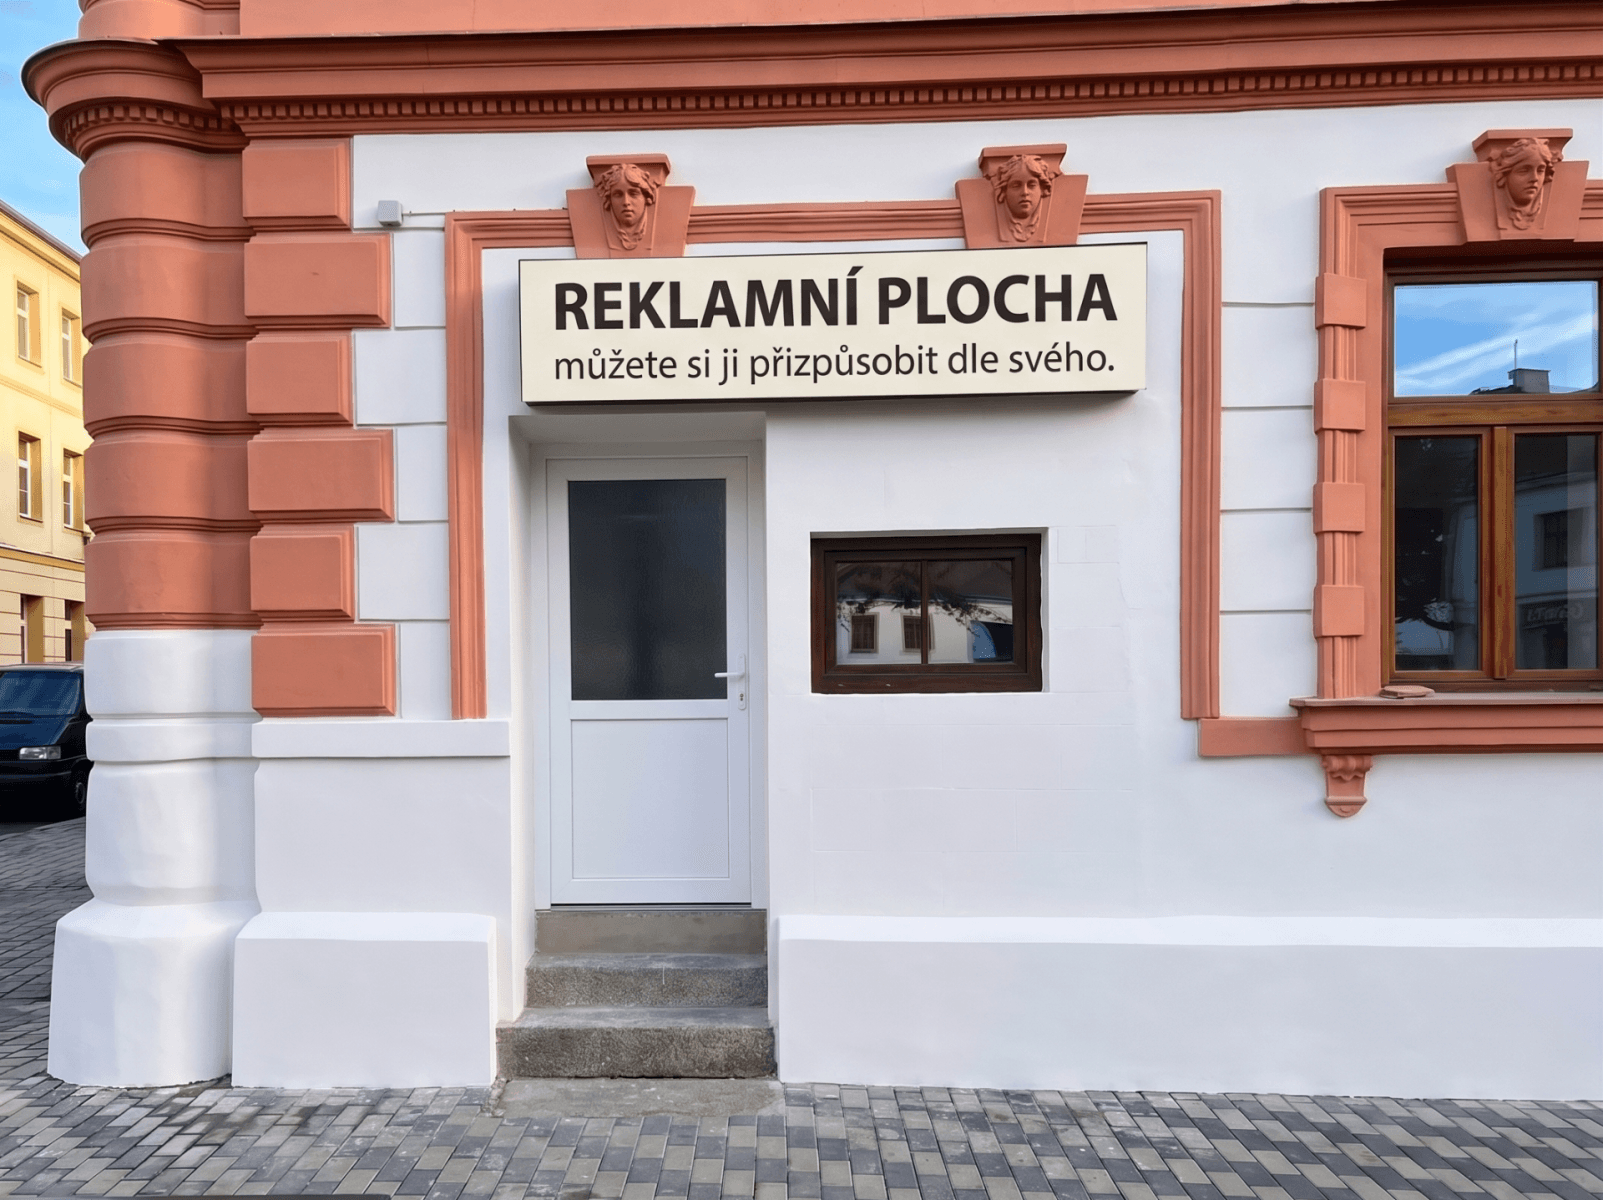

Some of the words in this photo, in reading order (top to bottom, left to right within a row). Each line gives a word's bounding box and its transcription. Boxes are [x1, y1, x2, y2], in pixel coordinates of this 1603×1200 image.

[555, 265, 863, 330] REKLAMNÍ
[878, 273, 1117, 324] PLOCHA
[555, 347, 676, 379] můžete
[687, 348, 709, 378] si
[718, 348, 737, 385] ji
[750, 344, 937, 384] přizpůsobit
[948, 342, 998, 374] dle
[1009, 341, 1114, 373] svého.
